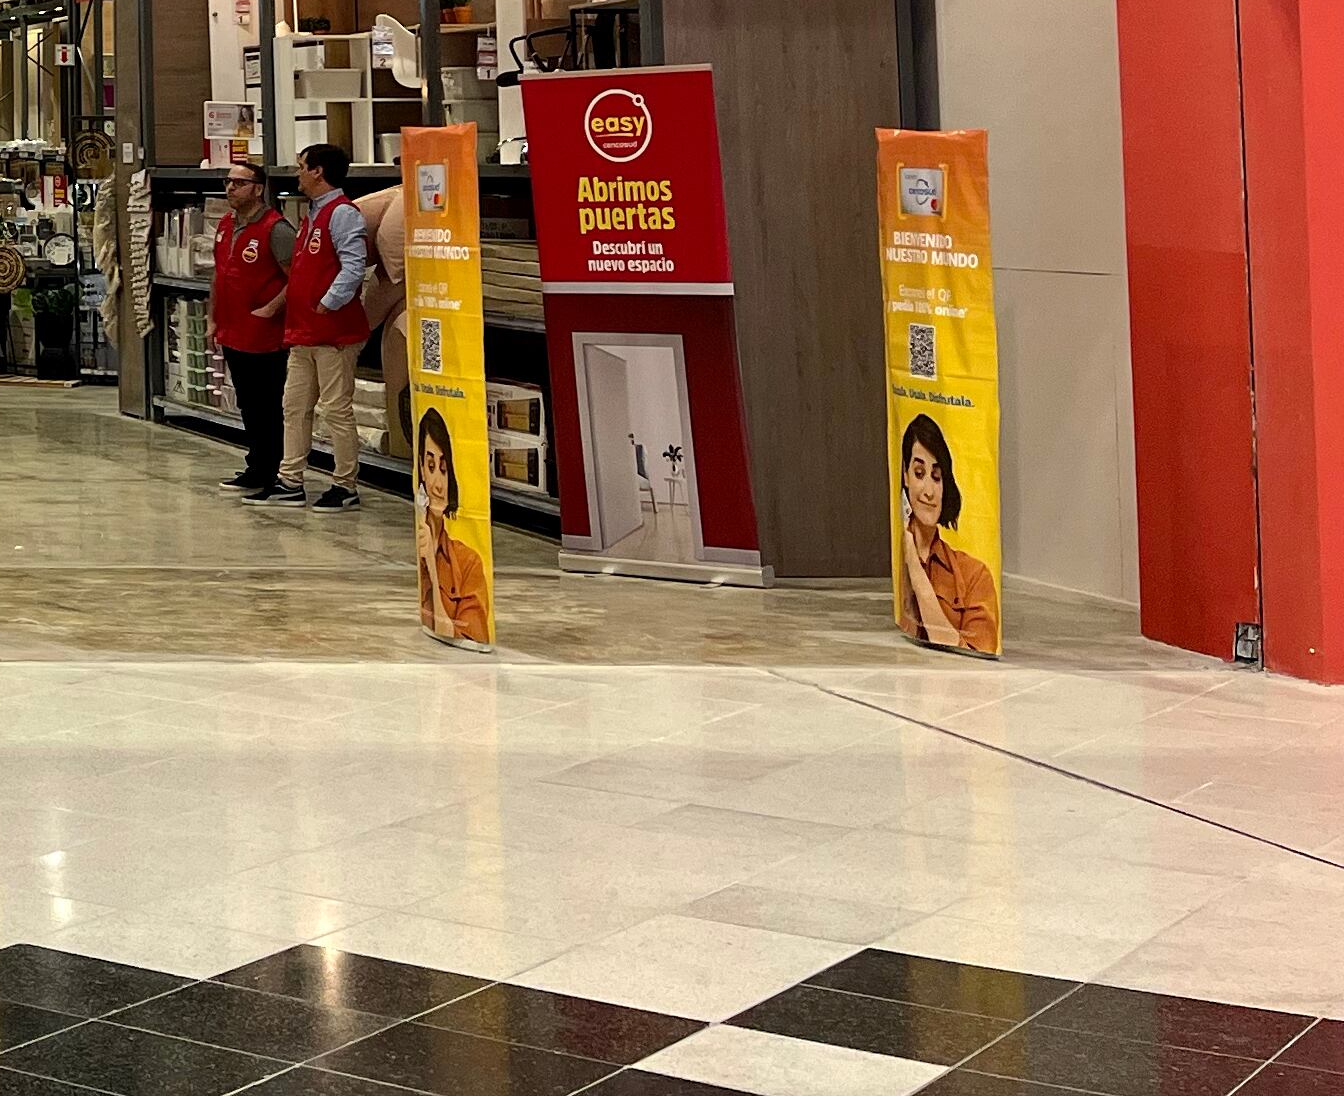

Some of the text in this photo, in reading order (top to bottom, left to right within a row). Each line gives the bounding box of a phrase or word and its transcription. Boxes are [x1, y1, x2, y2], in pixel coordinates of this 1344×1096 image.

[591, 116, 645, 136] easy
[578, 176, 673, 202] Abrimos
[579, 204, 676, 234] puertas
[592, 241, 663, 255] Descubrí un
[588, 257, 675, 273] nuevo espacio
[931, 251, 979, 269] MUNDO
